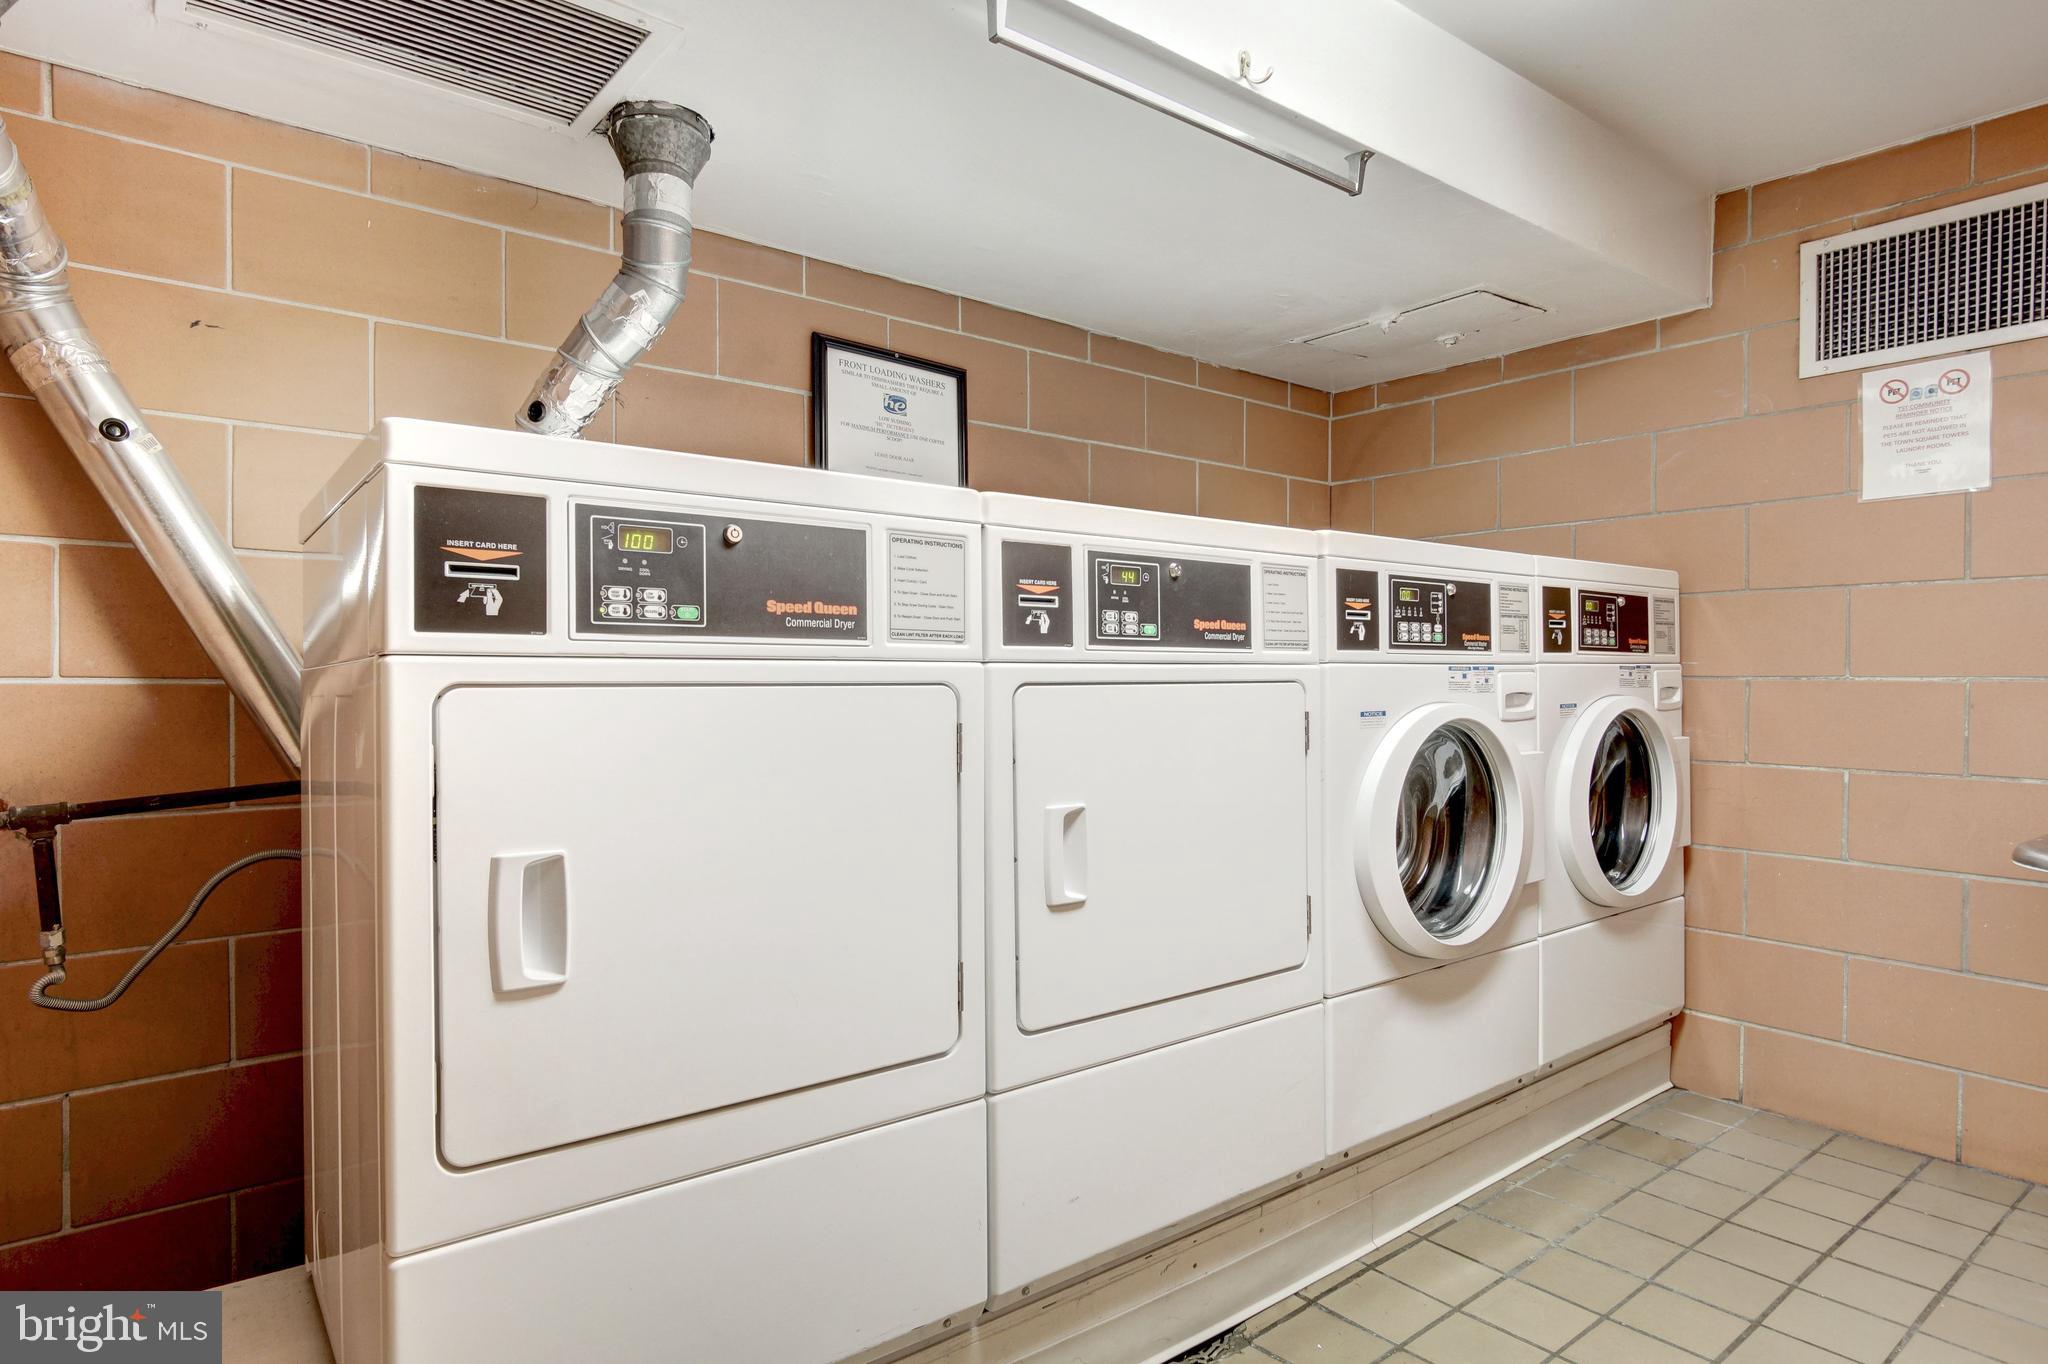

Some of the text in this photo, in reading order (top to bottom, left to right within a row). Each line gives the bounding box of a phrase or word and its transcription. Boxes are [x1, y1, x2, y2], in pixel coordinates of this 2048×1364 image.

[838, 359, 946, 390] FRONT LOADING WASHERS
[841, 369, 862, 378] SIMILAR
[919, 386, 939, 395] REQUIRE
[871, 382, 887, 390] SMALL
[889, 386, 909, 394] AMOUNT
[1887, 388, 1901, 396] PET
[1910, 400, 1950, 411] COMMUNITY
[1896, 406, 1952, 419] REMINDER NOTICE
[1915, 417, 1949, 425] REMINDED
[851, 423, 875, 432] MAXIMUM
[876, 427, 909, 439] PERFORMANCE
[886, 423, 915, 433] DETERGENT
[1927, 424, 1958, 432] ALLOWED
[1942, 431, 1969, 439] TOWERS
[1896, 445, 1925, 453] LAUNDRY
[446, 539, 474, 548] INSERT
[475, 541, 497, 549] CARD
[625, 533, 653, 550] 100
[892, 537, 963, 549] OPERATING INSTRUCTIONS
[1122, 571, 1135, 583] 44
[766, 599, 857, 616] Speed Queen
[785, 616, 855, 630] Commercial Dryer
[1194, 619, 1246, 631] Speed Queen
[1205, 632, 1245, 642] Commercial Dryer
